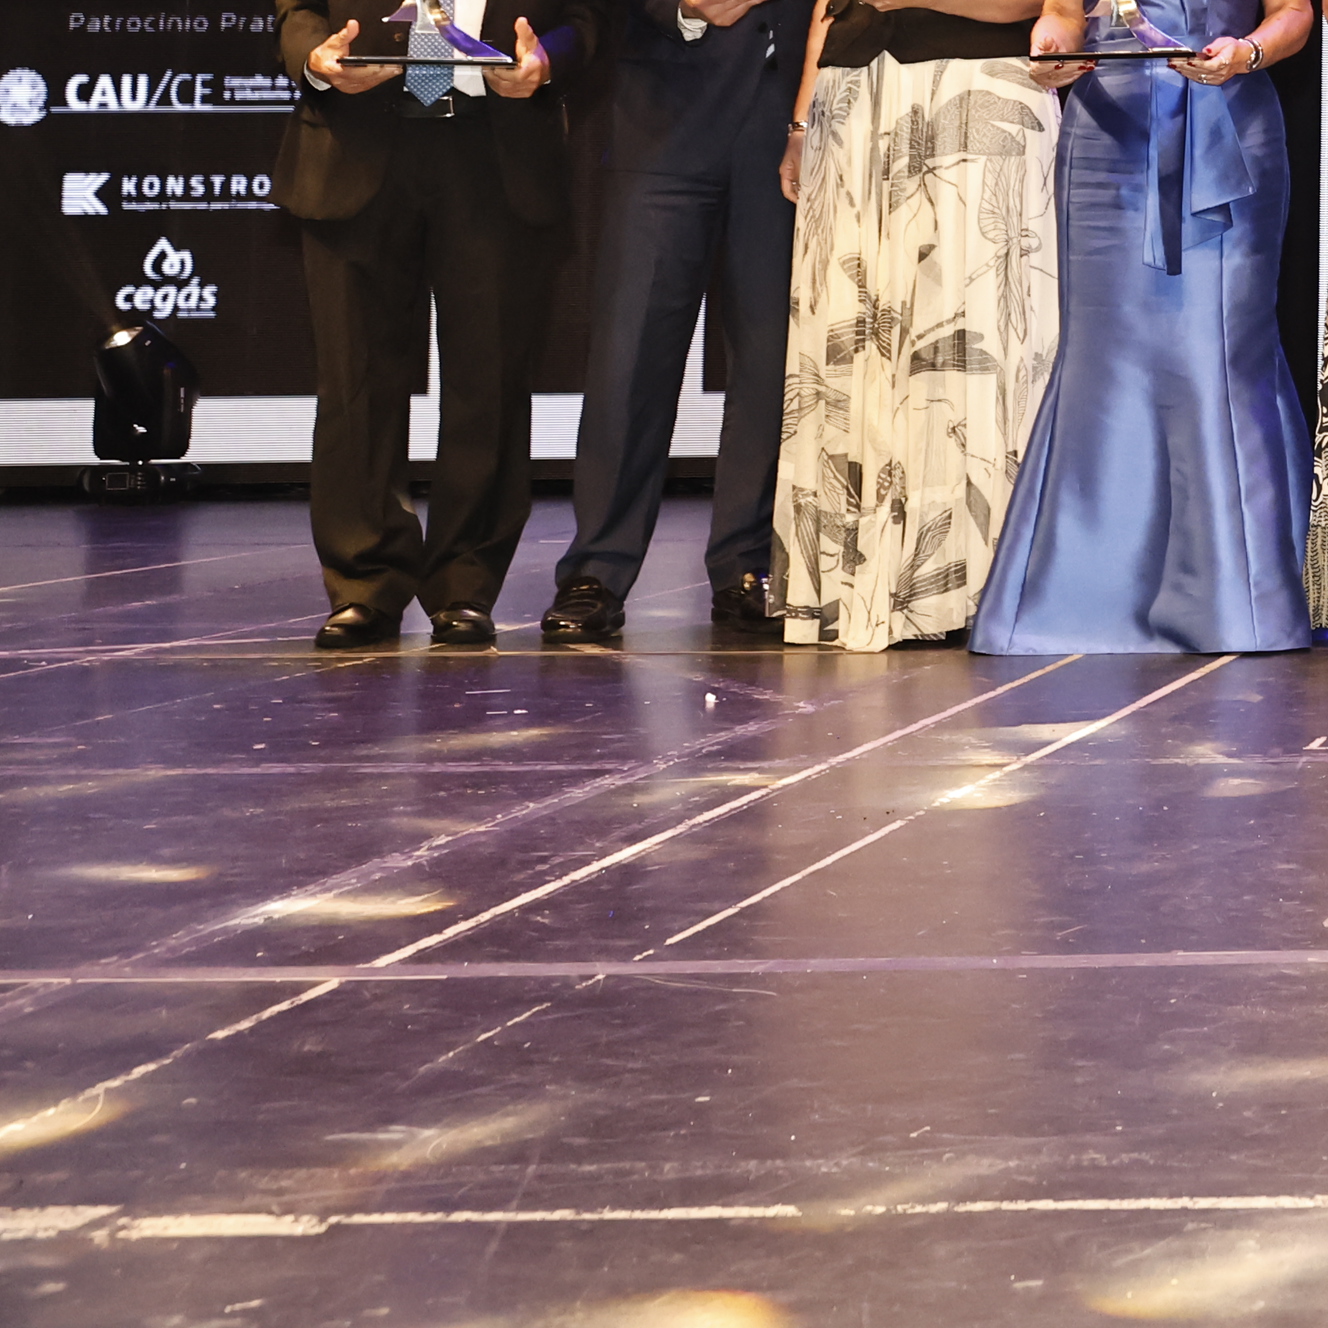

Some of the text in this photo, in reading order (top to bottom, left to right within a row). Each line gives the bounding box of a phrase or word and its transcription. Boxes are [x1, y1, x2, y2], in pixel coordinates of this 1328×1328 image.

[69, 12, 275, 33] Patrocínio Prat
[64, 69, 215, 110] CAU/CE
